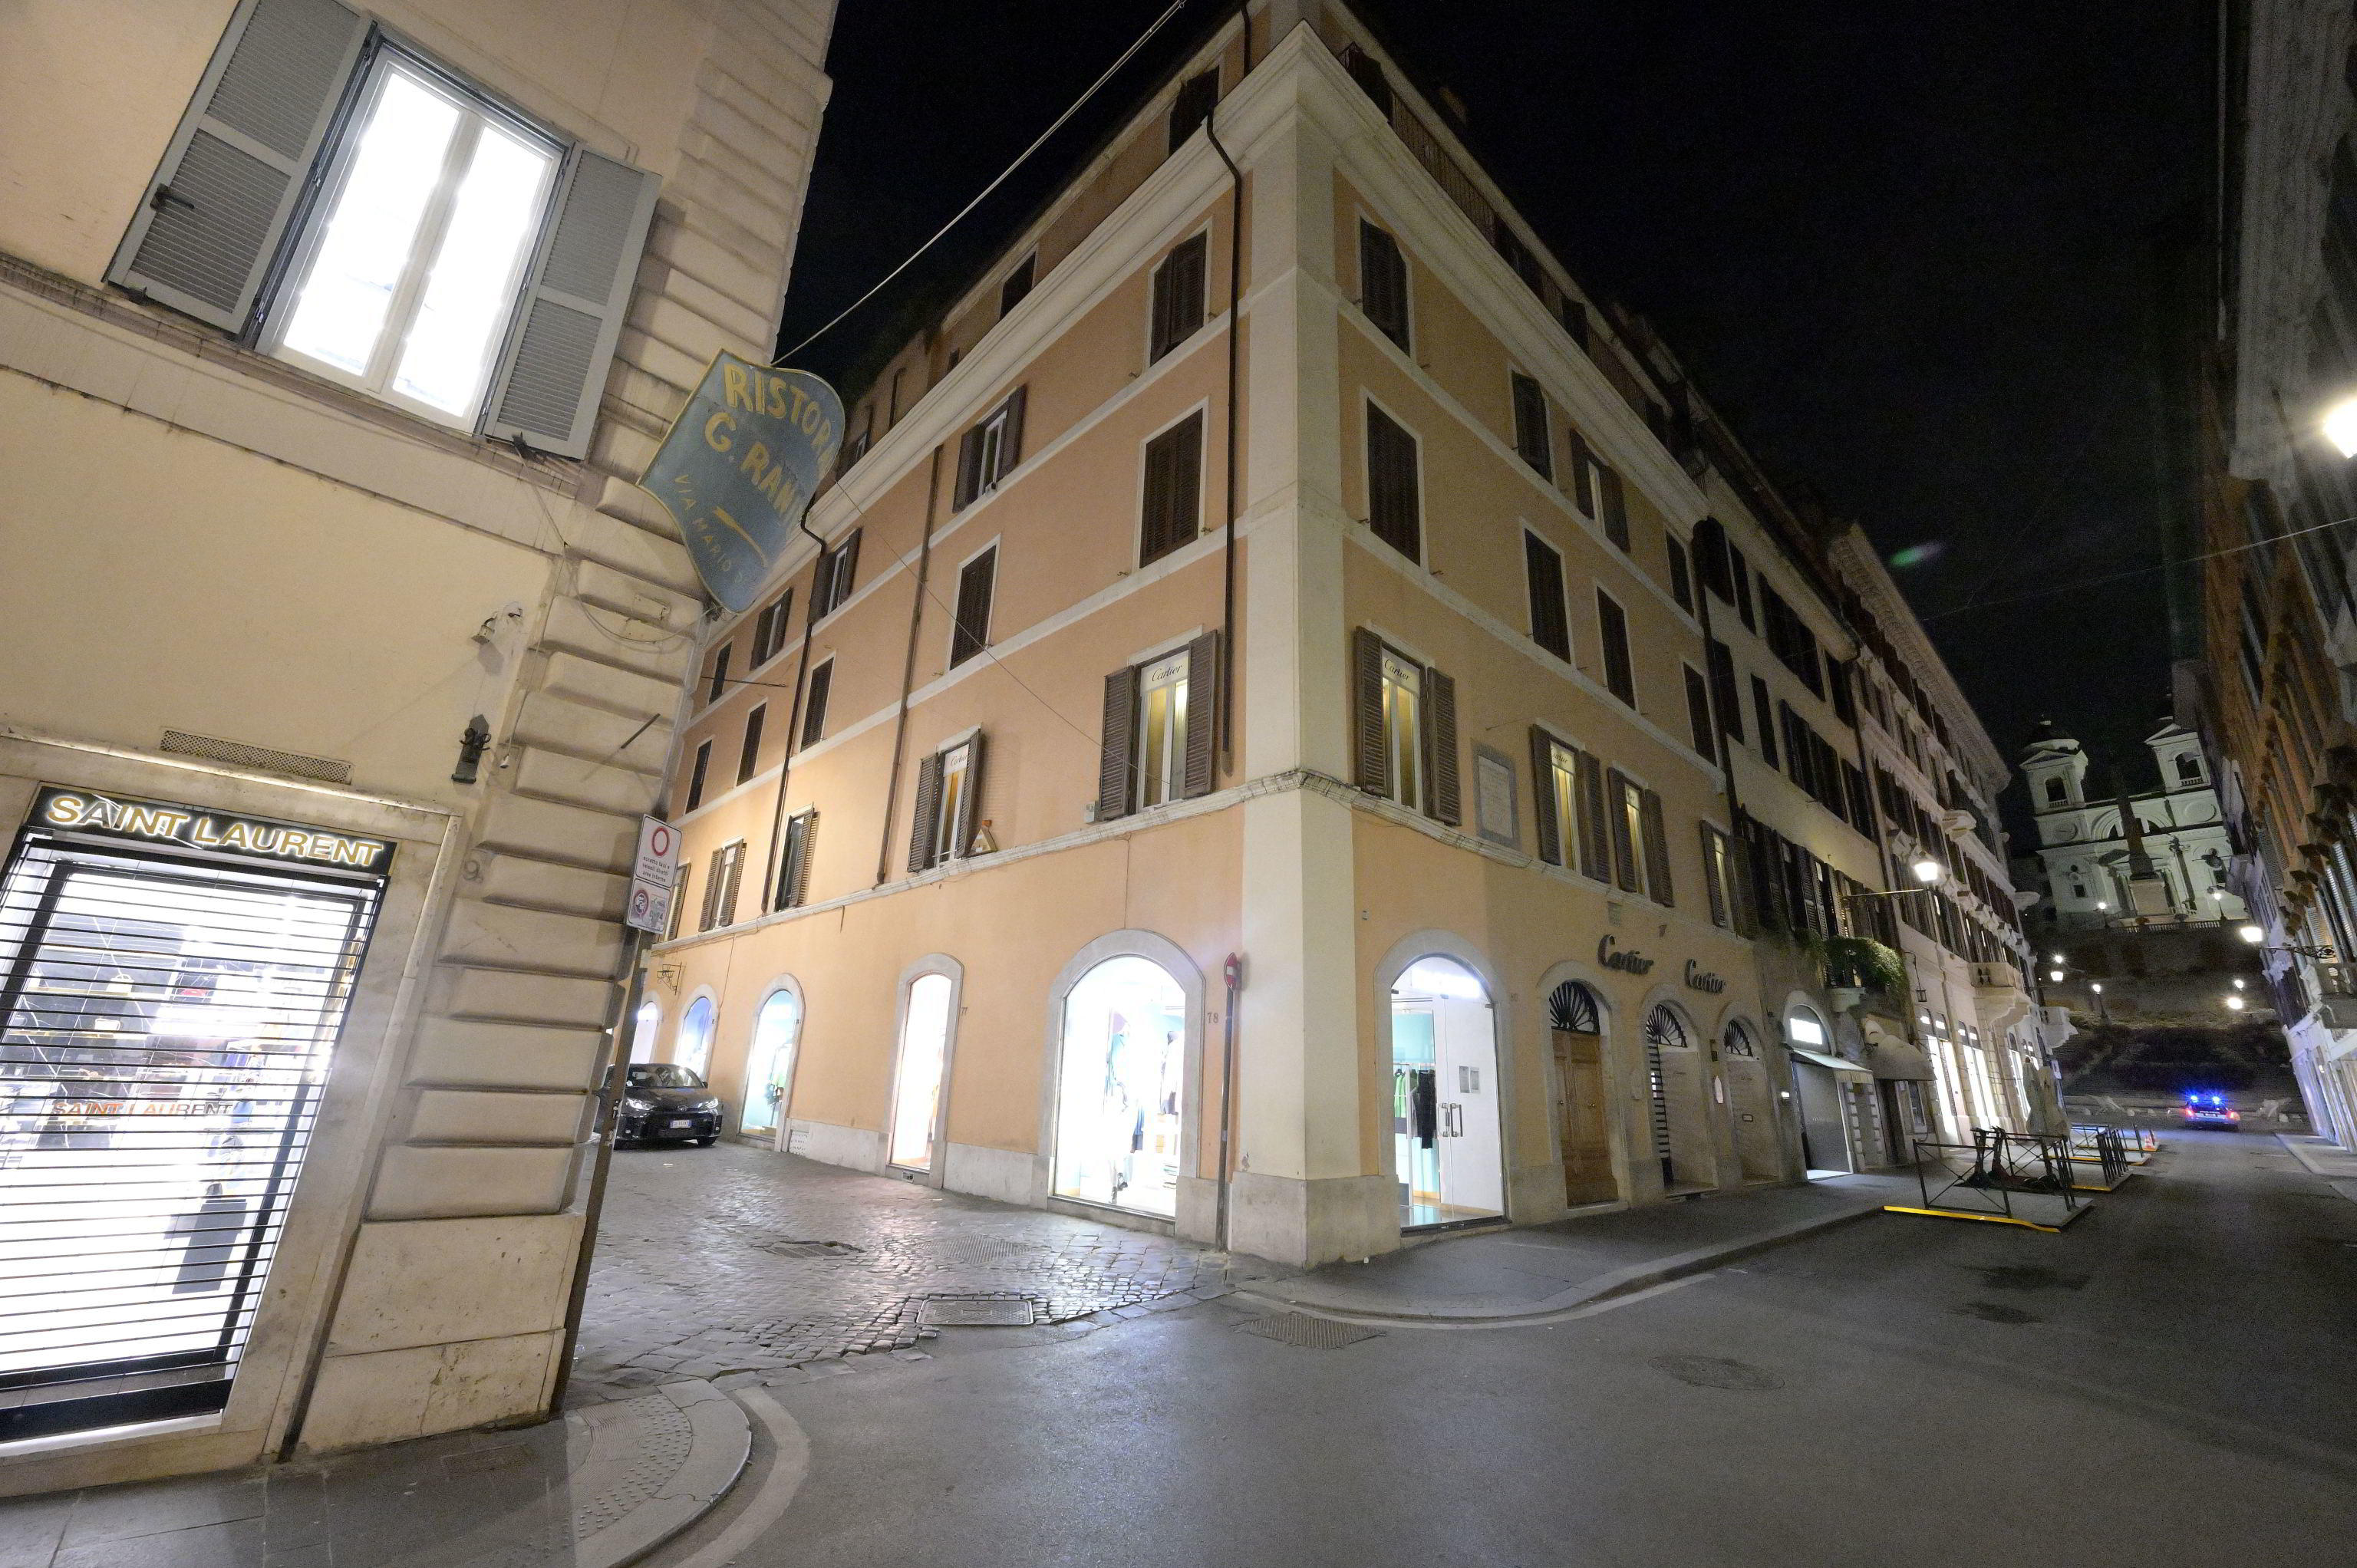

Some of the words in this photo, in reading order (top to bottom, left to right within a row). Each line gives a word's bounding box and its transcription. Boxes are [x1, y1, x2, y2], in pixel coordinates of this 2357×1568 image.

[674, 474, 697, 510] VIA
[1152, 665, 1182, 681] Cartier
[1384, 657, 1411, 680] Cartier
[48, 796, 190, 838] SAINT
[194, 815, 383, 867] LAURENT
[1597, 934, 1654, 975] Cartier
[1684, 959, 1726, 993] Cartier
[1207, 1012, 1219, 1023] 78
[51, 1102, 124, 1115] SAINT
